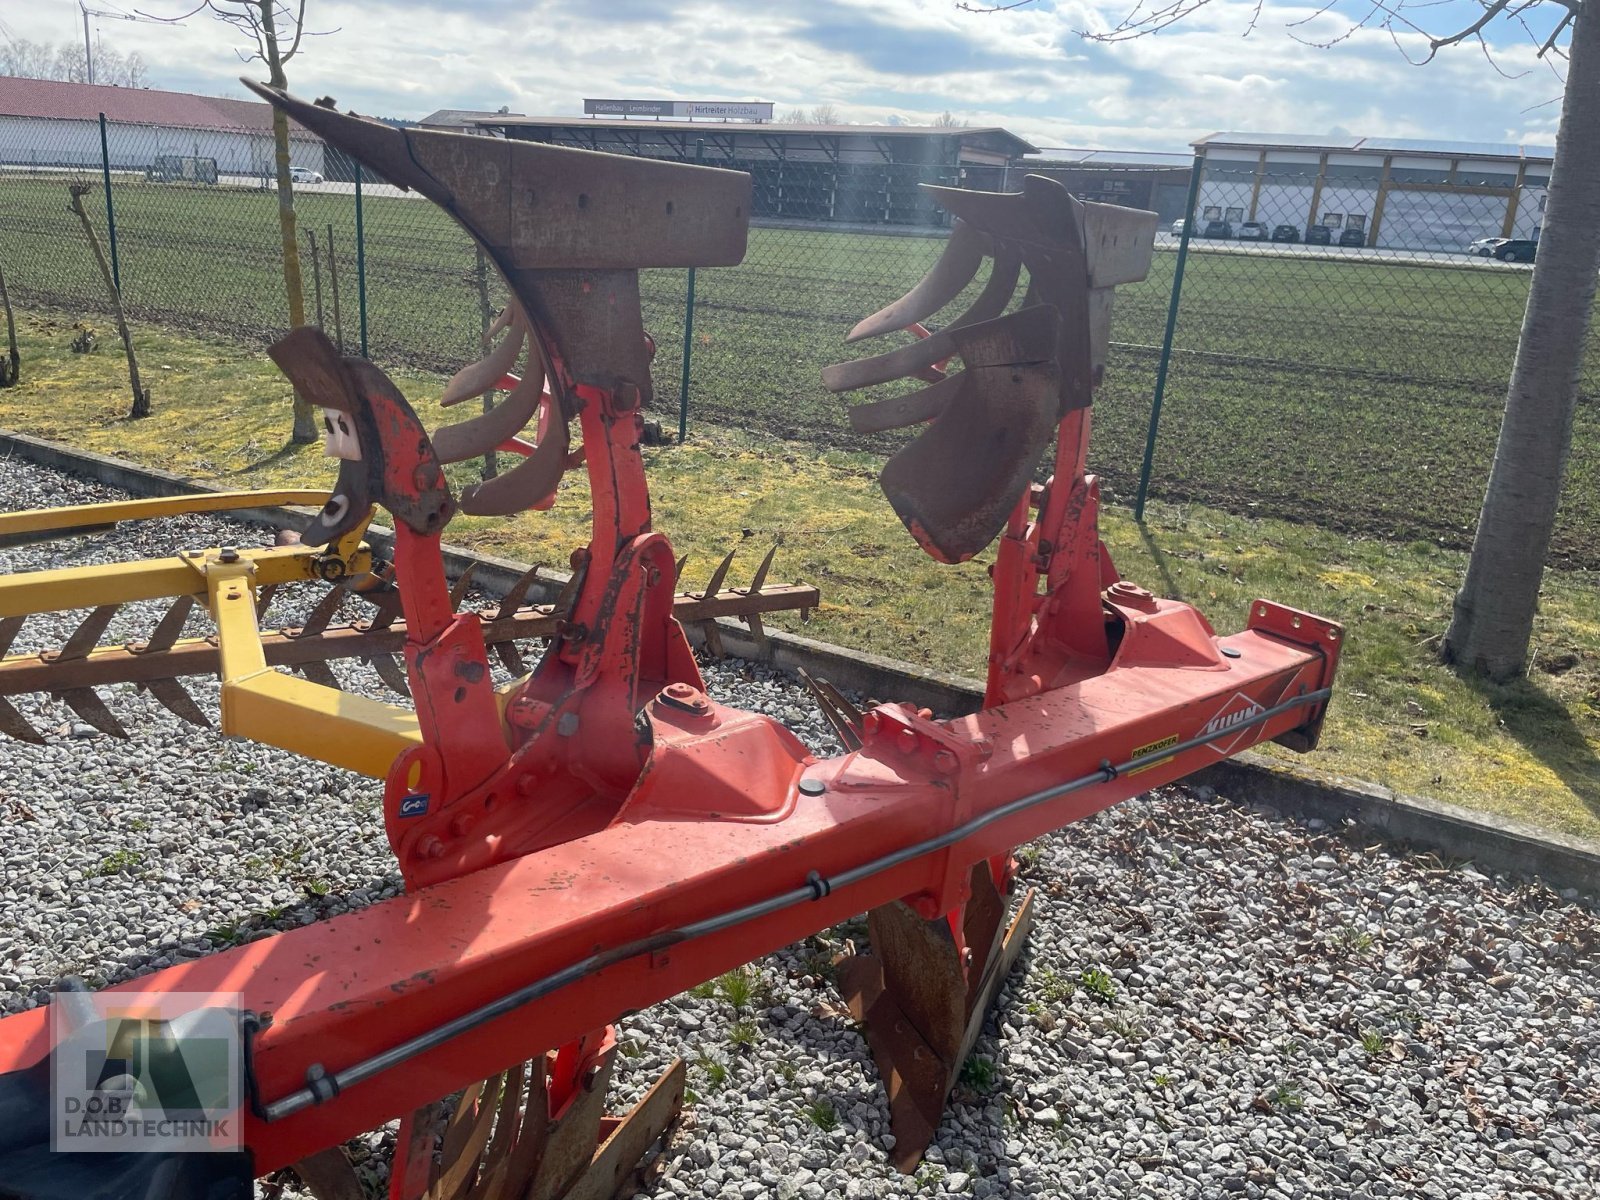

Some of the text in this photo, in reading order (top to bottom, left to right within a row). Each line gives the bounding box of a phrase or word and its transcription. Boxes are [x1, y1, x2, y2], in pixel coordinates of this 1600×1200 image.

[595, 104, 624, 112] Hallenbau
[695, 106, 758, 115] Hirtreiter Holzbau
[1132, 736, 1177, 758] PENZKOFER
